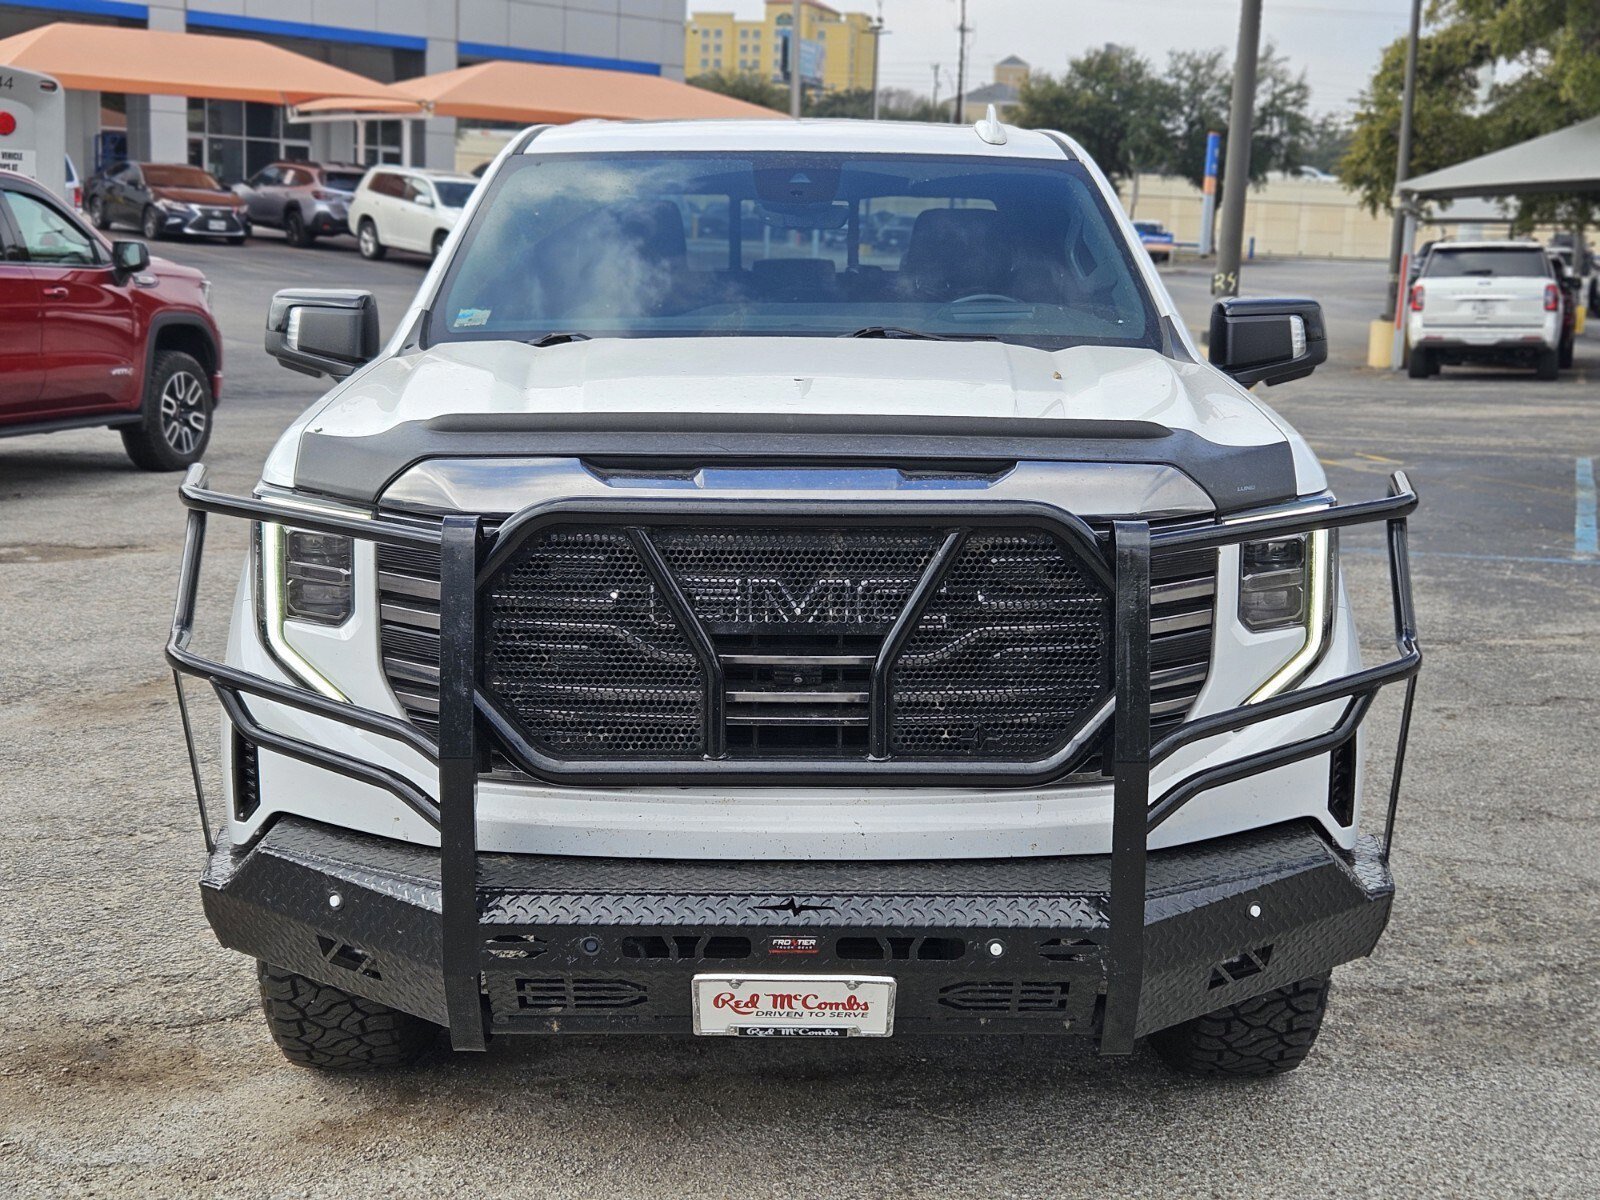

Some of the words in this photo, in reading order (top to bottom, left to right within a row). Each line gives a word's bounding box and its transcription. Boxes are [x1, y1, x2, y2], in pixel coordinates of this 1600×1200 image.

[1, 151, 23, 160] VEHICLE
[713, 992, 759, 1016] Red
[764, 992, 870, 1012] McCombs
[755, 1010, 805, 1019] DRIVEN
[829, 1011, 869, 1019] SERVE
[746, 1027, 776, 1037] Red
[777, 1027, 839, 1037] McCombs
